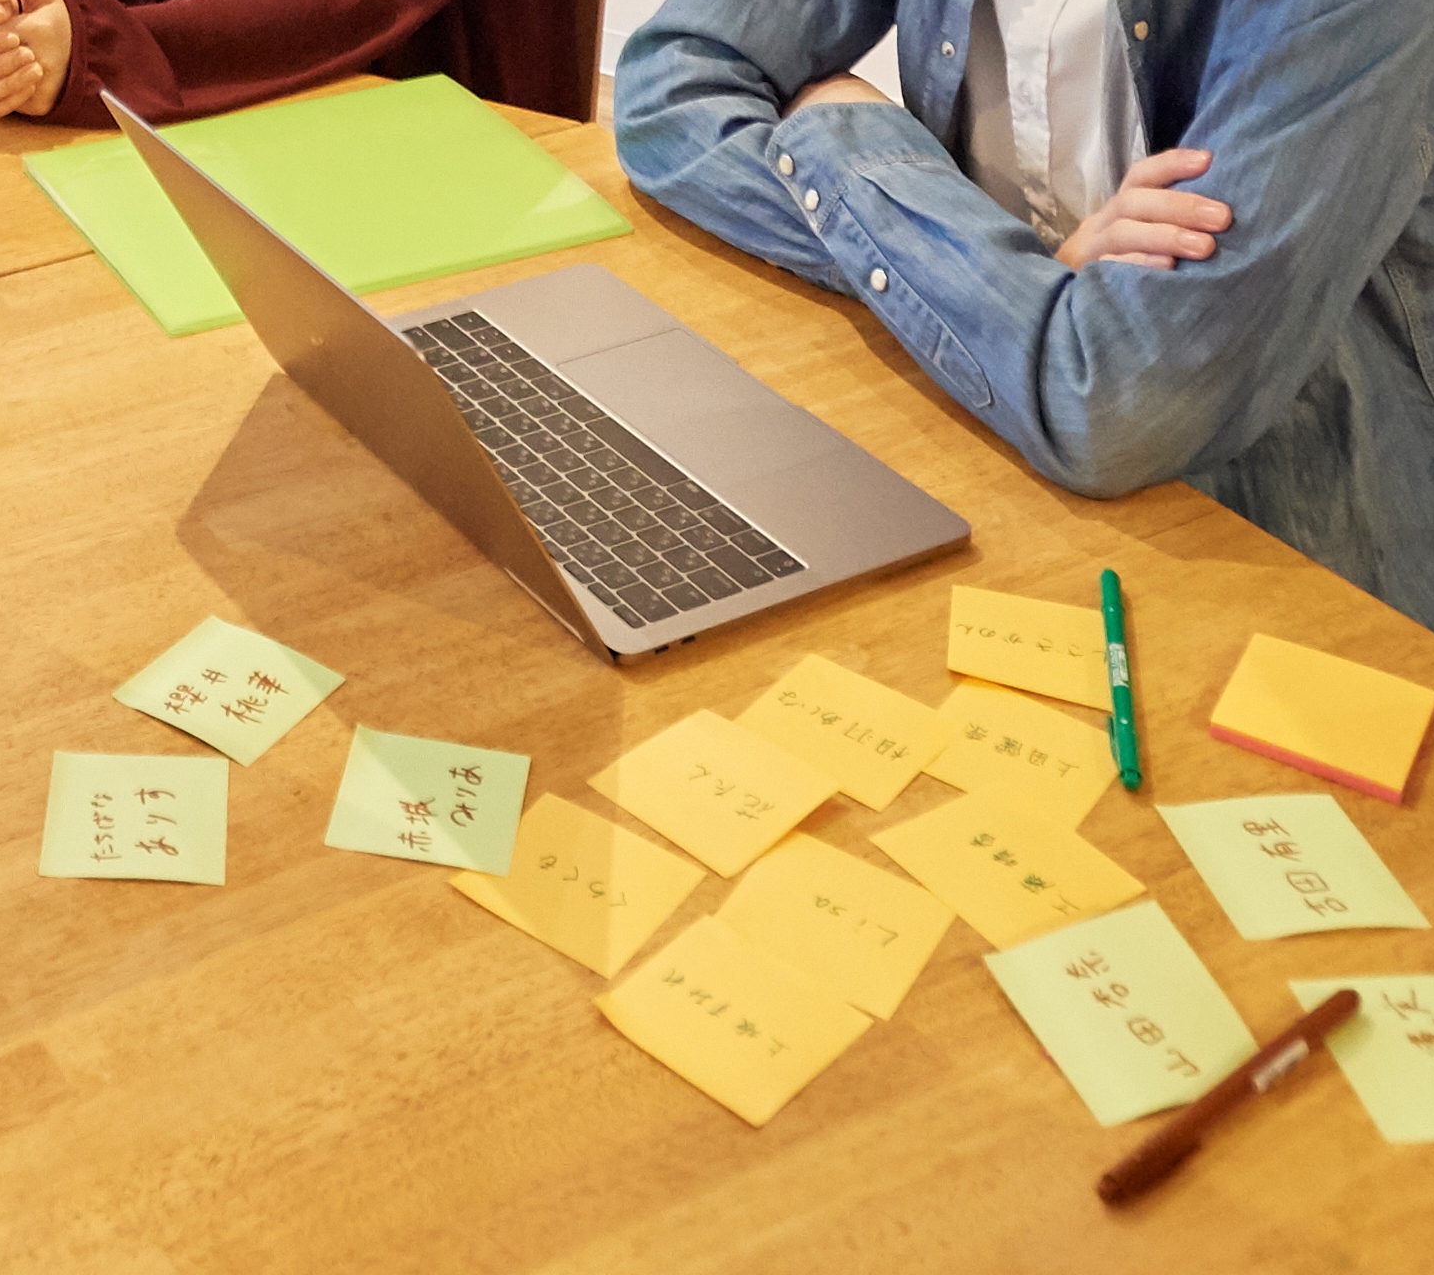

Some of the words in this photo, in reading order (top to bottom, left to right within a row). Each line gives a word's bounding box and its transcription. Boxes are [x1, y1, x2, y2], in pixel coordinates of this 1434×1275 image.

[133, 787, 178, 857] ありす
[397, 797, 437, 852] 赤城
[448, 764, 484, 828] みりあ
[687, 763, 777, 822] 花たん
[89, 792, 122, 863] たちばな
[1063, 948, 1202, 1079] 山田杏奈
